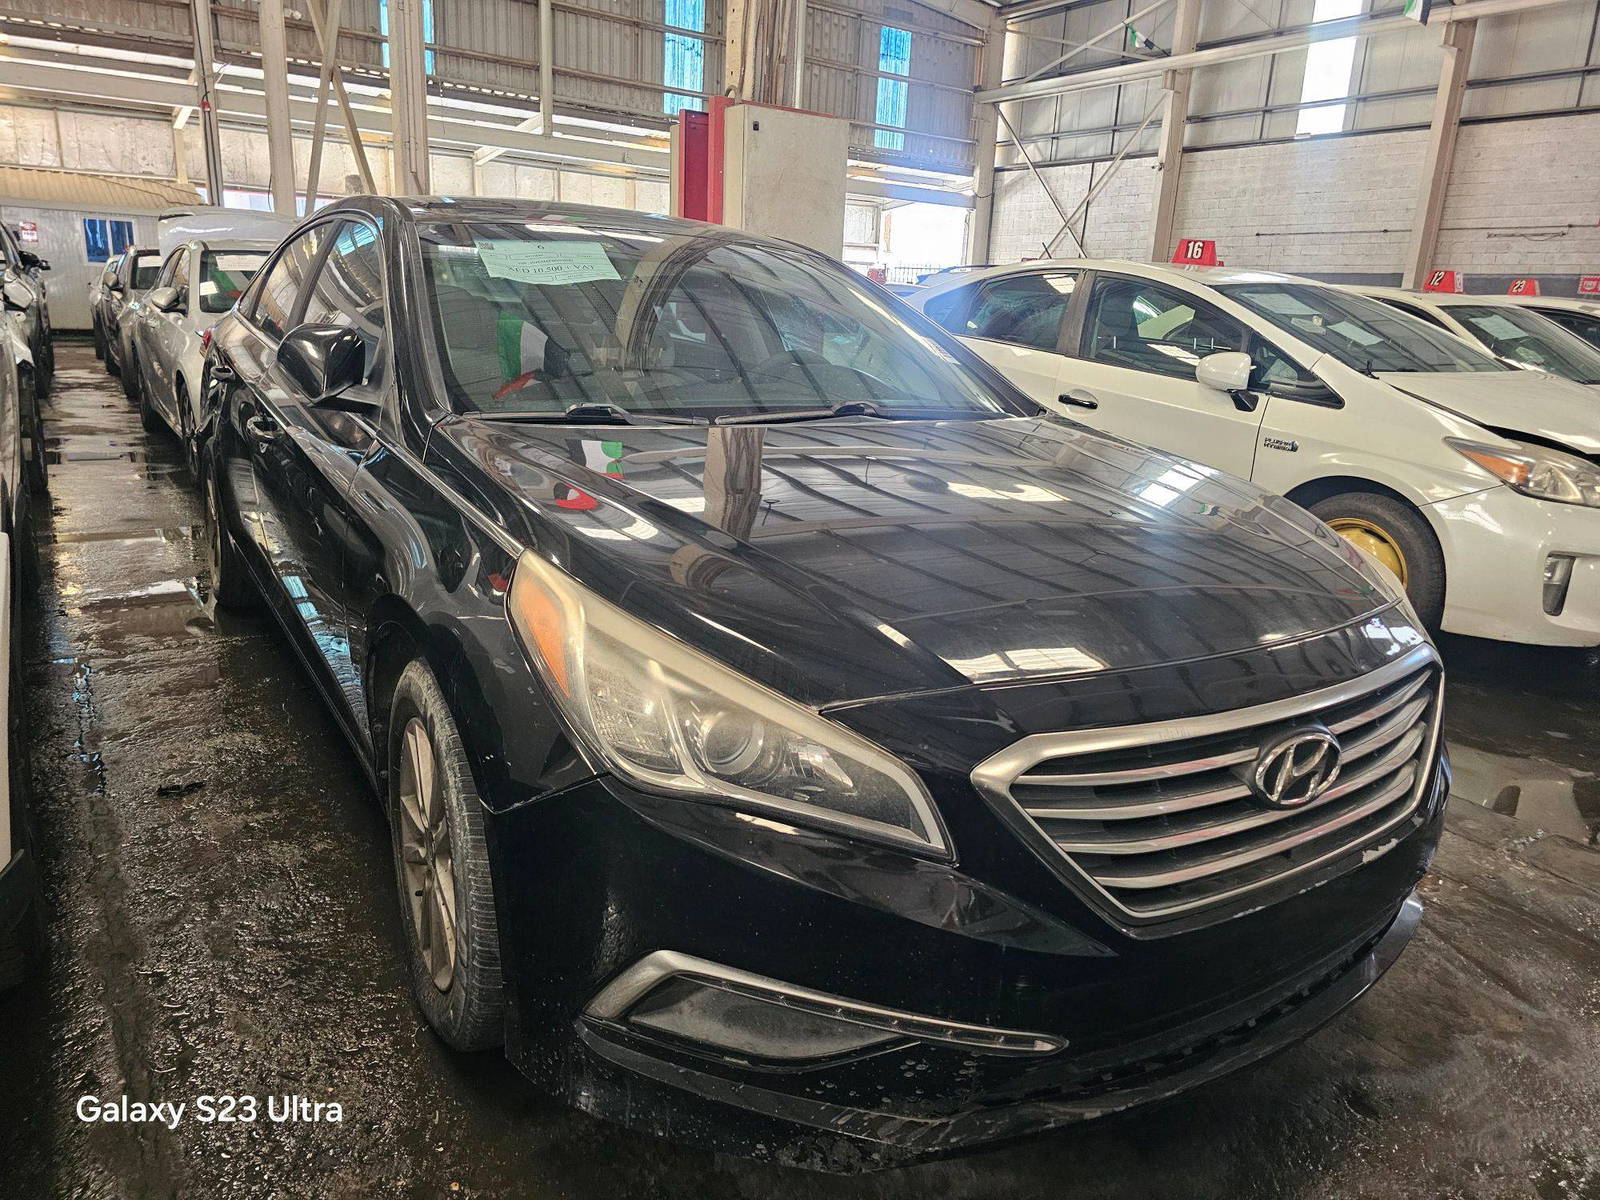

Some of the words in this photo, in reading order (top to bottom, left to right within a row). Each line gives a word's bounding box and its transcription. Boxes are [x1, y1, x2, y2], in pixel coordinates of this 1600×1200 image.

[1187, 241, 1203, 259] 16
[1430, 271, 1445, 286] 12
[1512, 279, 1527, 293] 23
